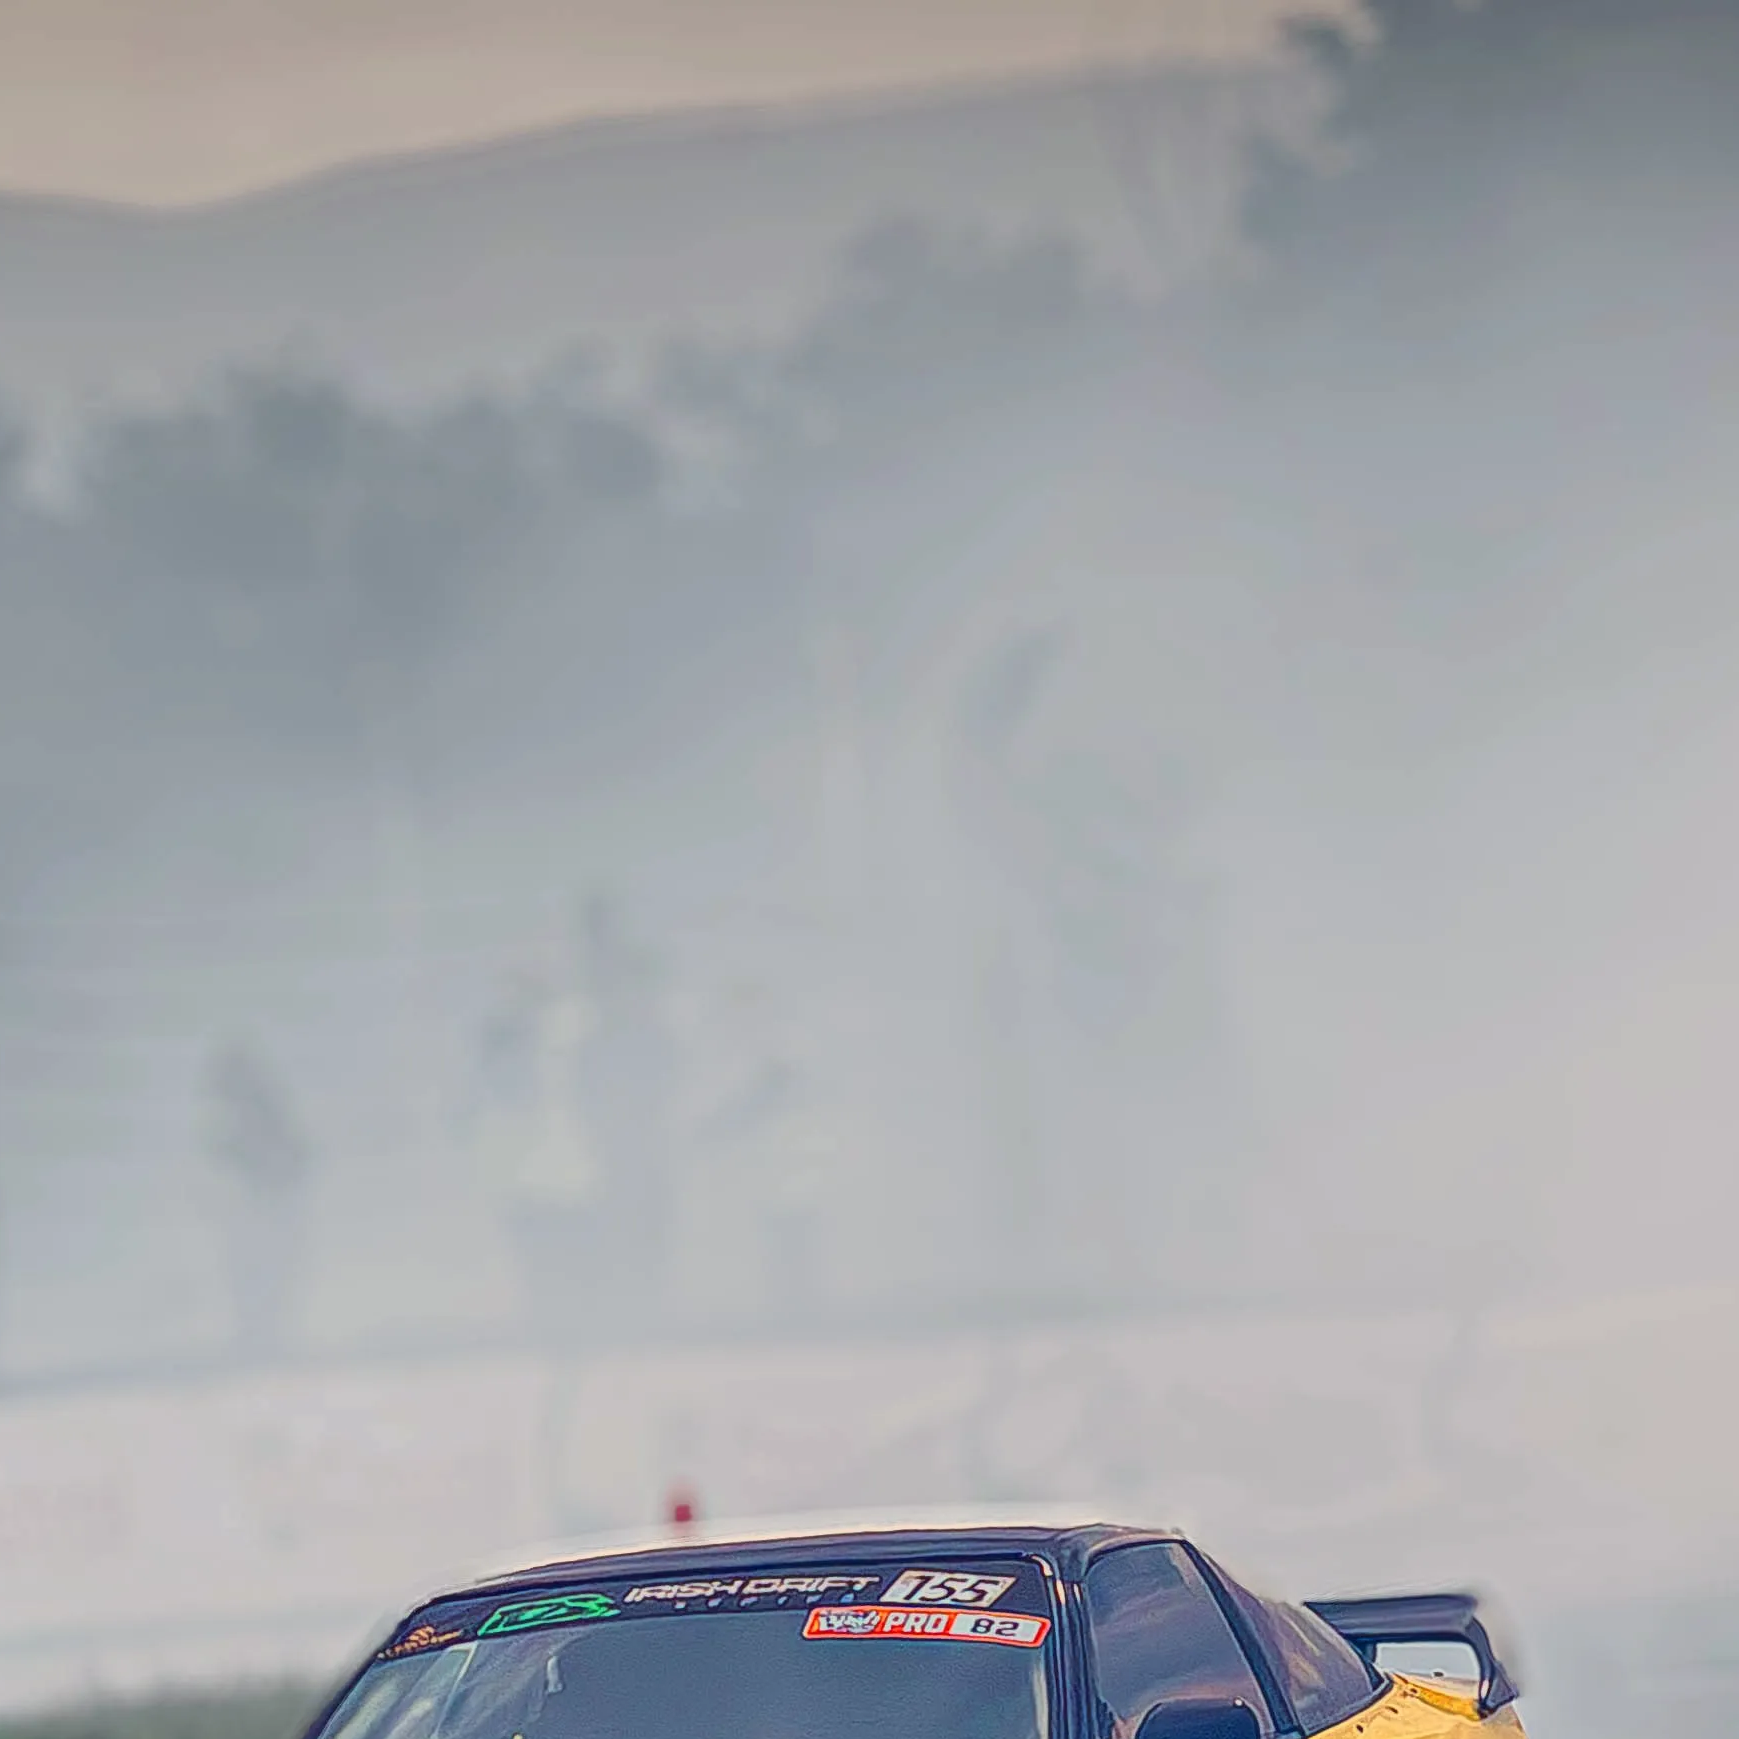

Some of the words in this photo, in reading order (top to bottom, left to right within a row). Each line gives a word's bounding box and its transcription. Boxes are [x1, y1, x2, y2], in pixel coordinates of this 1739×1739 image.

[623, 1579, 742, 1603] IRISH
[743, 1576, 880, 1596] DRIFT
[882, 1611, 950, 1633] PRO
[970, 1618, 1021, 1637] 82
